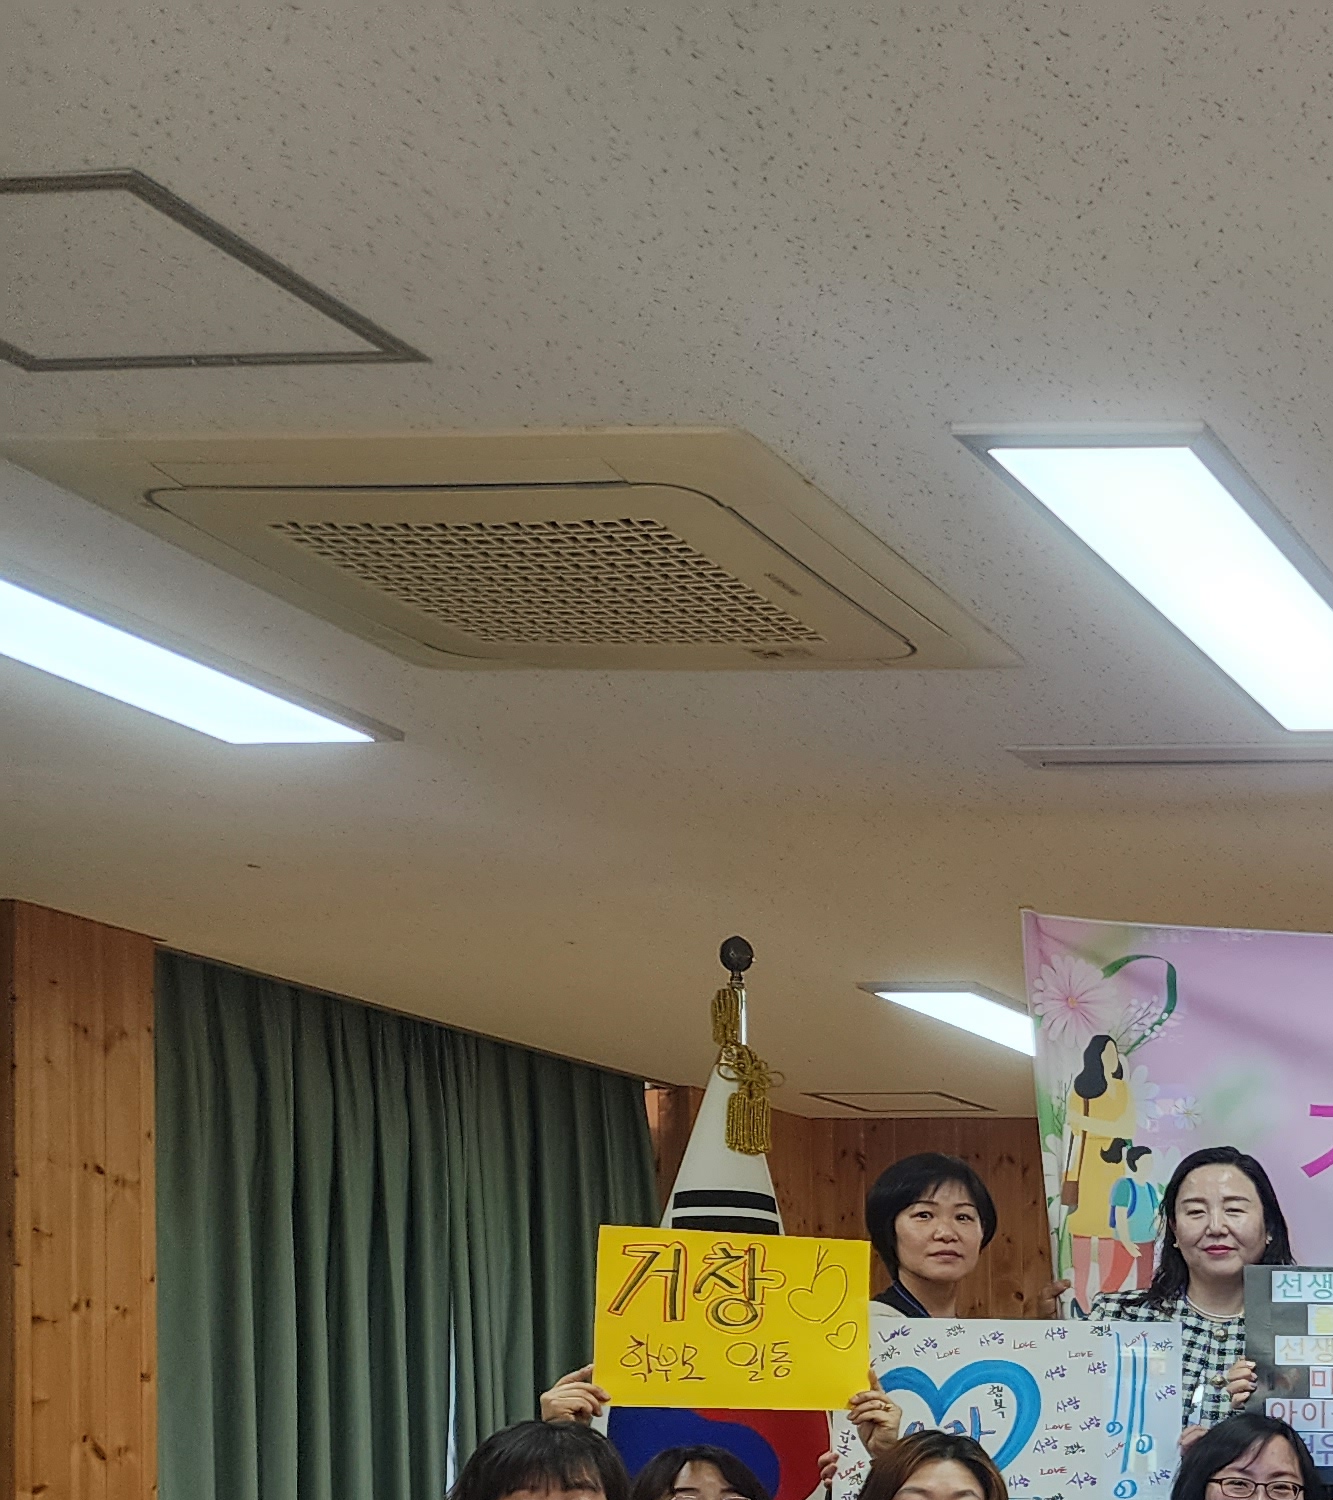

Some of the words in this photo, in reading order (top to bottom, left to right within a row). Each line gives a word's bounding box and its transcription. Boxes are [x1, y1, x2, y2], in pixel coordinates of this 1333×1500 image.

[608, 1241, 786, 1334] 거창
[620, 1333, 706, 1383] 학부모
[726, 1341, 793, 1382] 일동
